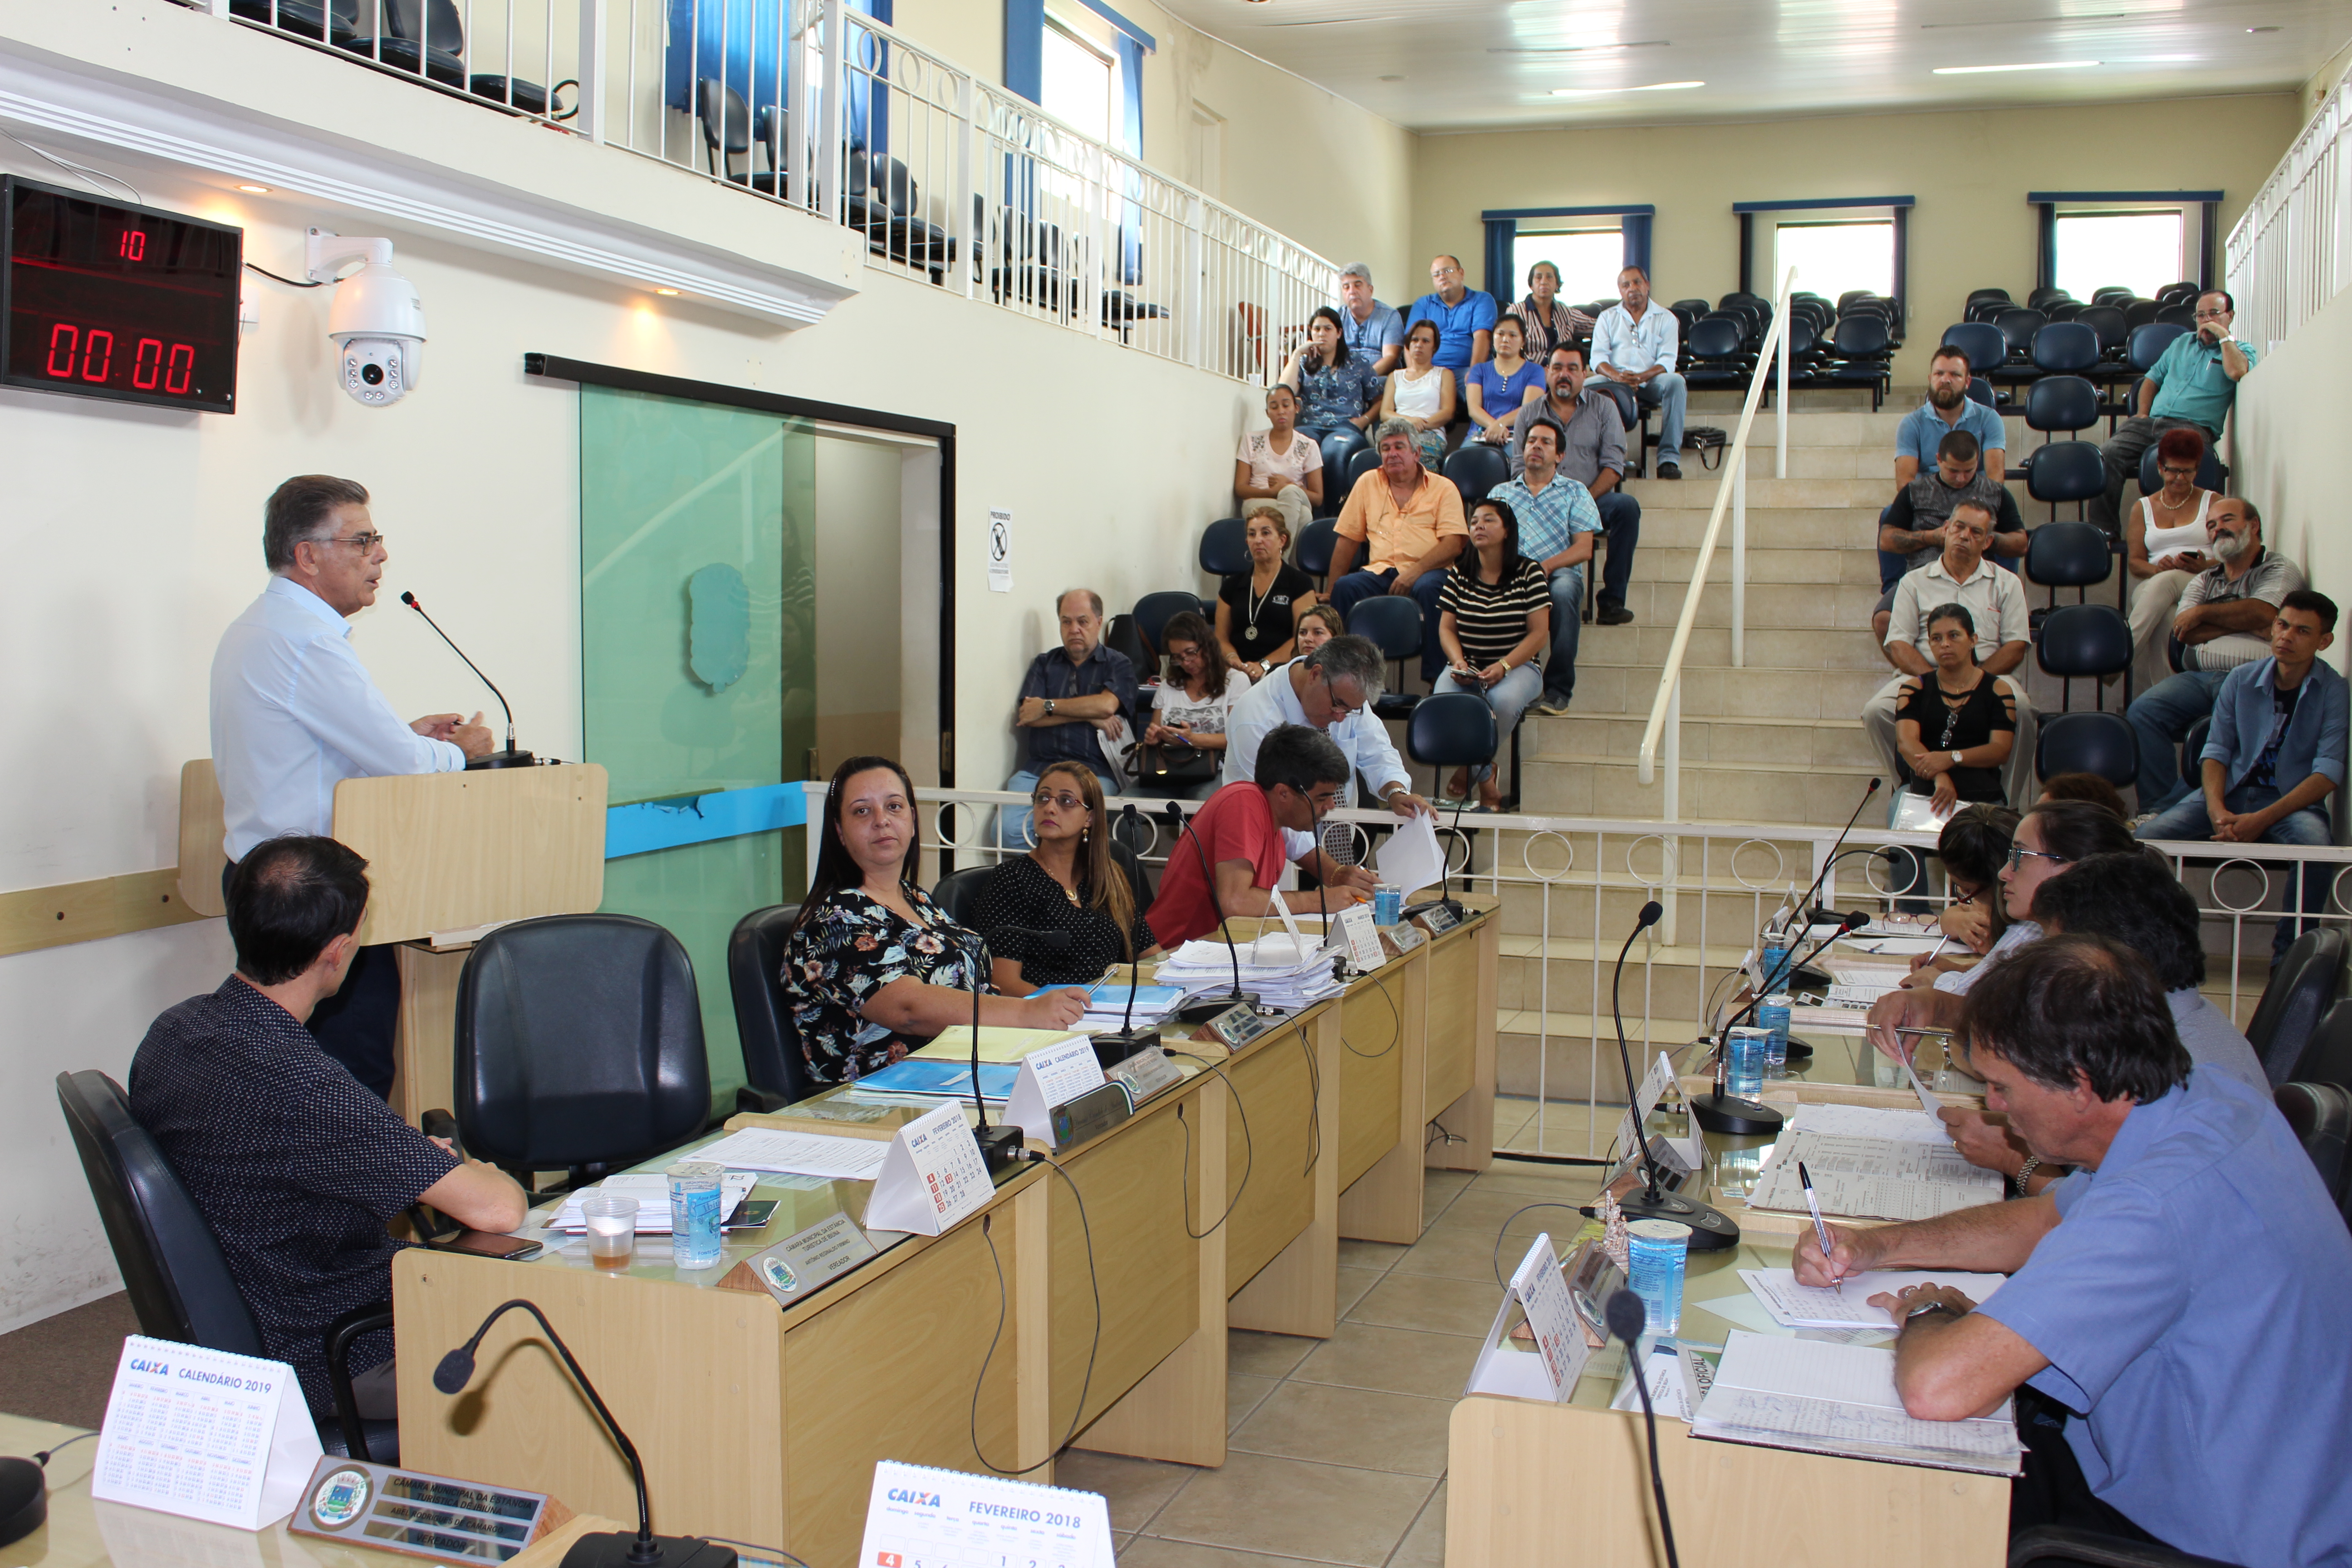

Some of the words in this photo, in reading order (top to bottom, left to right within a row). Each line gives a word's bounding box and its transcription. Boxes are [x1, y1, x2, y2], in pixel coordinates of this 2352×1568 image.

[120, 230, 146, 261] 10
[990, 510, 1011, 520] PROIBIDO
[1036, 1058, 1053, 1070] CAIXA
[1055, 1050, 1079, 1063] CALENDÁRIO
[1078, 1046, 1089, 1055] 2019
[911, 1133, 927, 1148] CAIXA
[932, 1119, 952, 1135] FEVEREIRO
[951, 1113, 962, 1125] 2018
[786, 1240, 804, 1252] CÂMARA
[801, 1231, 823, 1243] MUNICIPAL
[828, 1255, 851, 1270] VEREADOR
[1525, 1282, 1536, 1303] CAIXA
[130, 1358, 170, 1376] CAIXA
[179, 1368, 242, 1388] CALENDÁRIO
[245, 1380, 272, 1394] 2019
[1692, 1358, 1711, 1384] OFICIAL
[393, 1478, 429, 1491] CÂMARA
[430, 1483, 474, 1499] MUNICIPAL
[476, 1493, 488, 1502] DA
[461, 1501, 473, 1509] DE
[475, 1502, 502, 1515] IBIÚNA
[887, 1487, 941, 1508] CAIXA
[969, 1501, 1041, 1522] FEVEREIRO
[1045, 1512, 1081, 1529] 2018
[391, 1507, 409, 1516] ABEL
[411, 1510, 453, 1524] RODRIGUES
[466, 1520, 504, 1534] CAMARGO
[886, 1505, 909, 1515] domingo
[914, 1510, 936, 1519] segunda
[1056, 1532, 1076, 1540] sábado
[416, 1532, 467, 1549] VEREADOR
[885, 1554, 895, 1567] 4
[1001, 1555, 1006, 1567] 1
